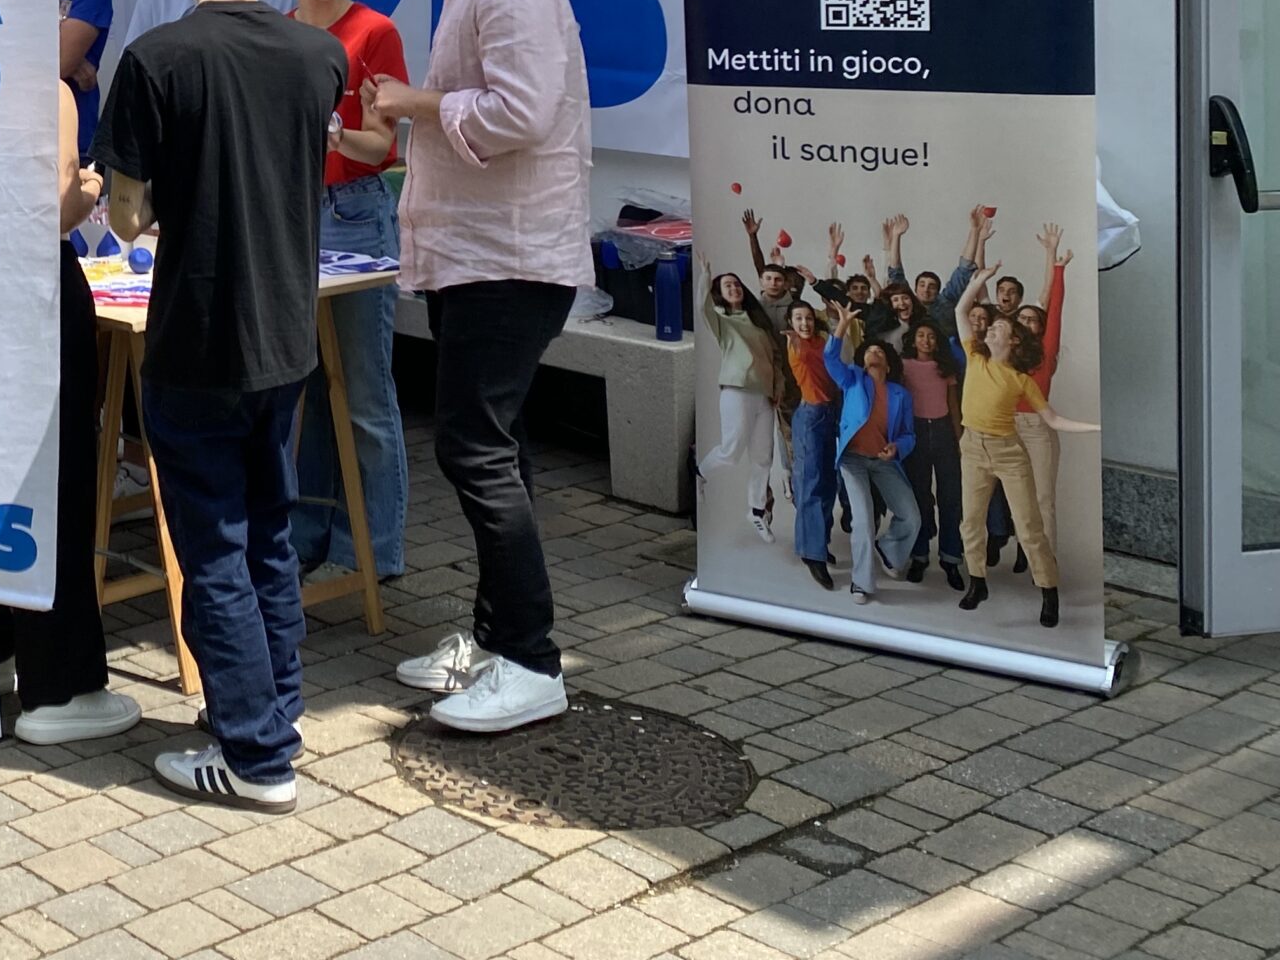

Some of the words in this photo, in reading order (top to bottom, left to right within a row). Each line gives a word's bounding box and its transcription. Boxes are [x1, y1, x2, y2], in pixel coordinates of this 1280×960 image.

[708, 47, 800, 73] Mettiti
[808, 49, 833, 73] in
[842, 49, 931, 80] gioco,
[734, 91, 815, 116] dona
[772, 135, 790, 160] il
[800, 141, 930, 171] sangue!
